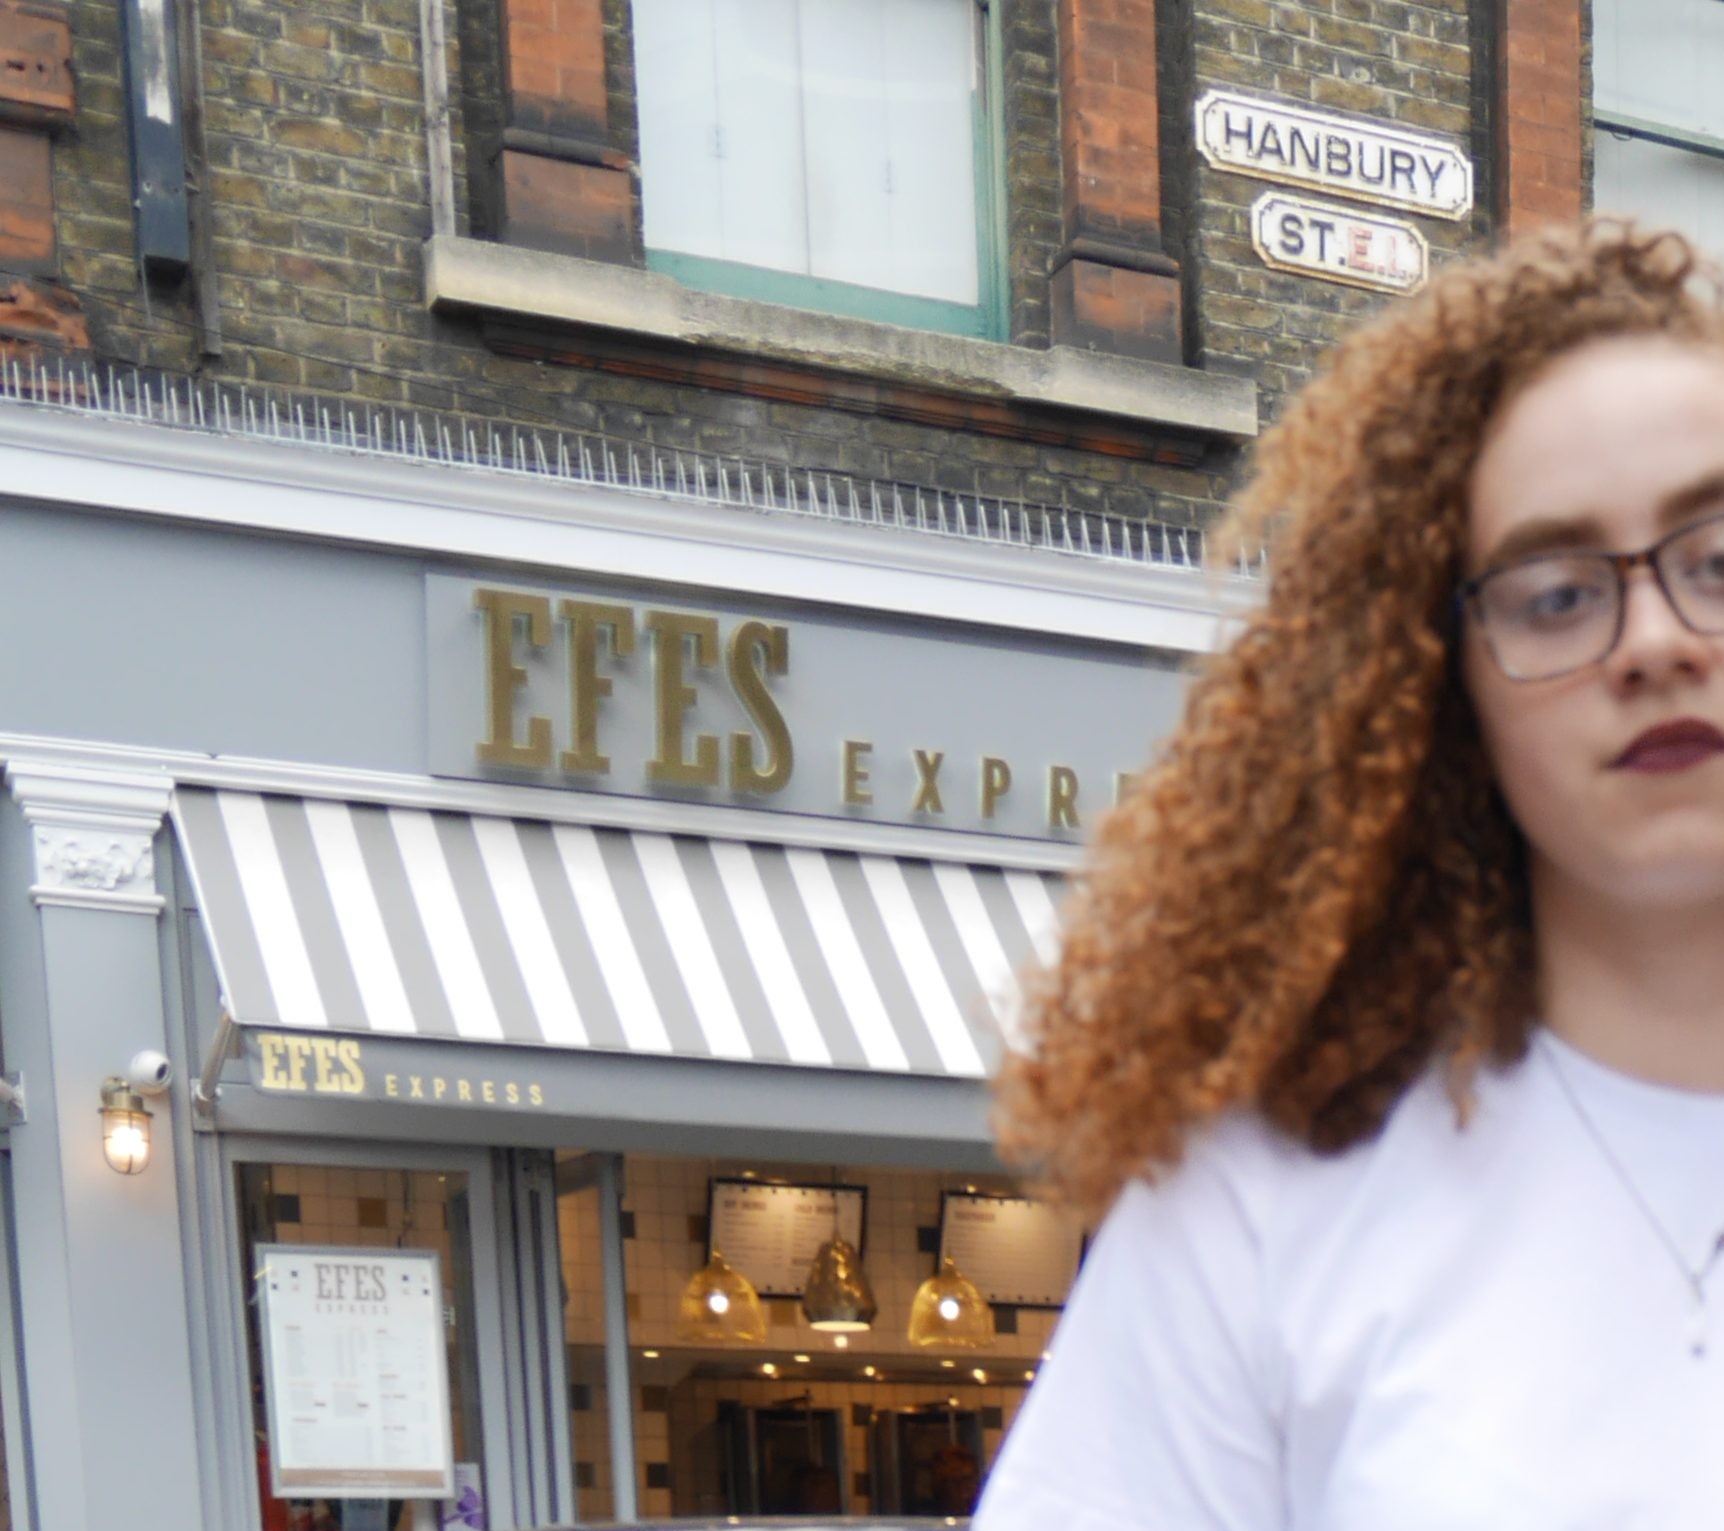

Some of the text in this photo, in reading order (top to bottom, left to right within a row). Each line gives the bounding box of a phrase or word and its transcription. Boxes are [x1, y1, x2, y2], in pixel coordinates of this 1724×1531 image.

[1223, 110, 1447, 198] HANBURY
[473, 588, 794, 795] EFES
[257, 1034, 543, 1105] EFES EXPRESS
[314, 1263, 387, 1302] EFES
